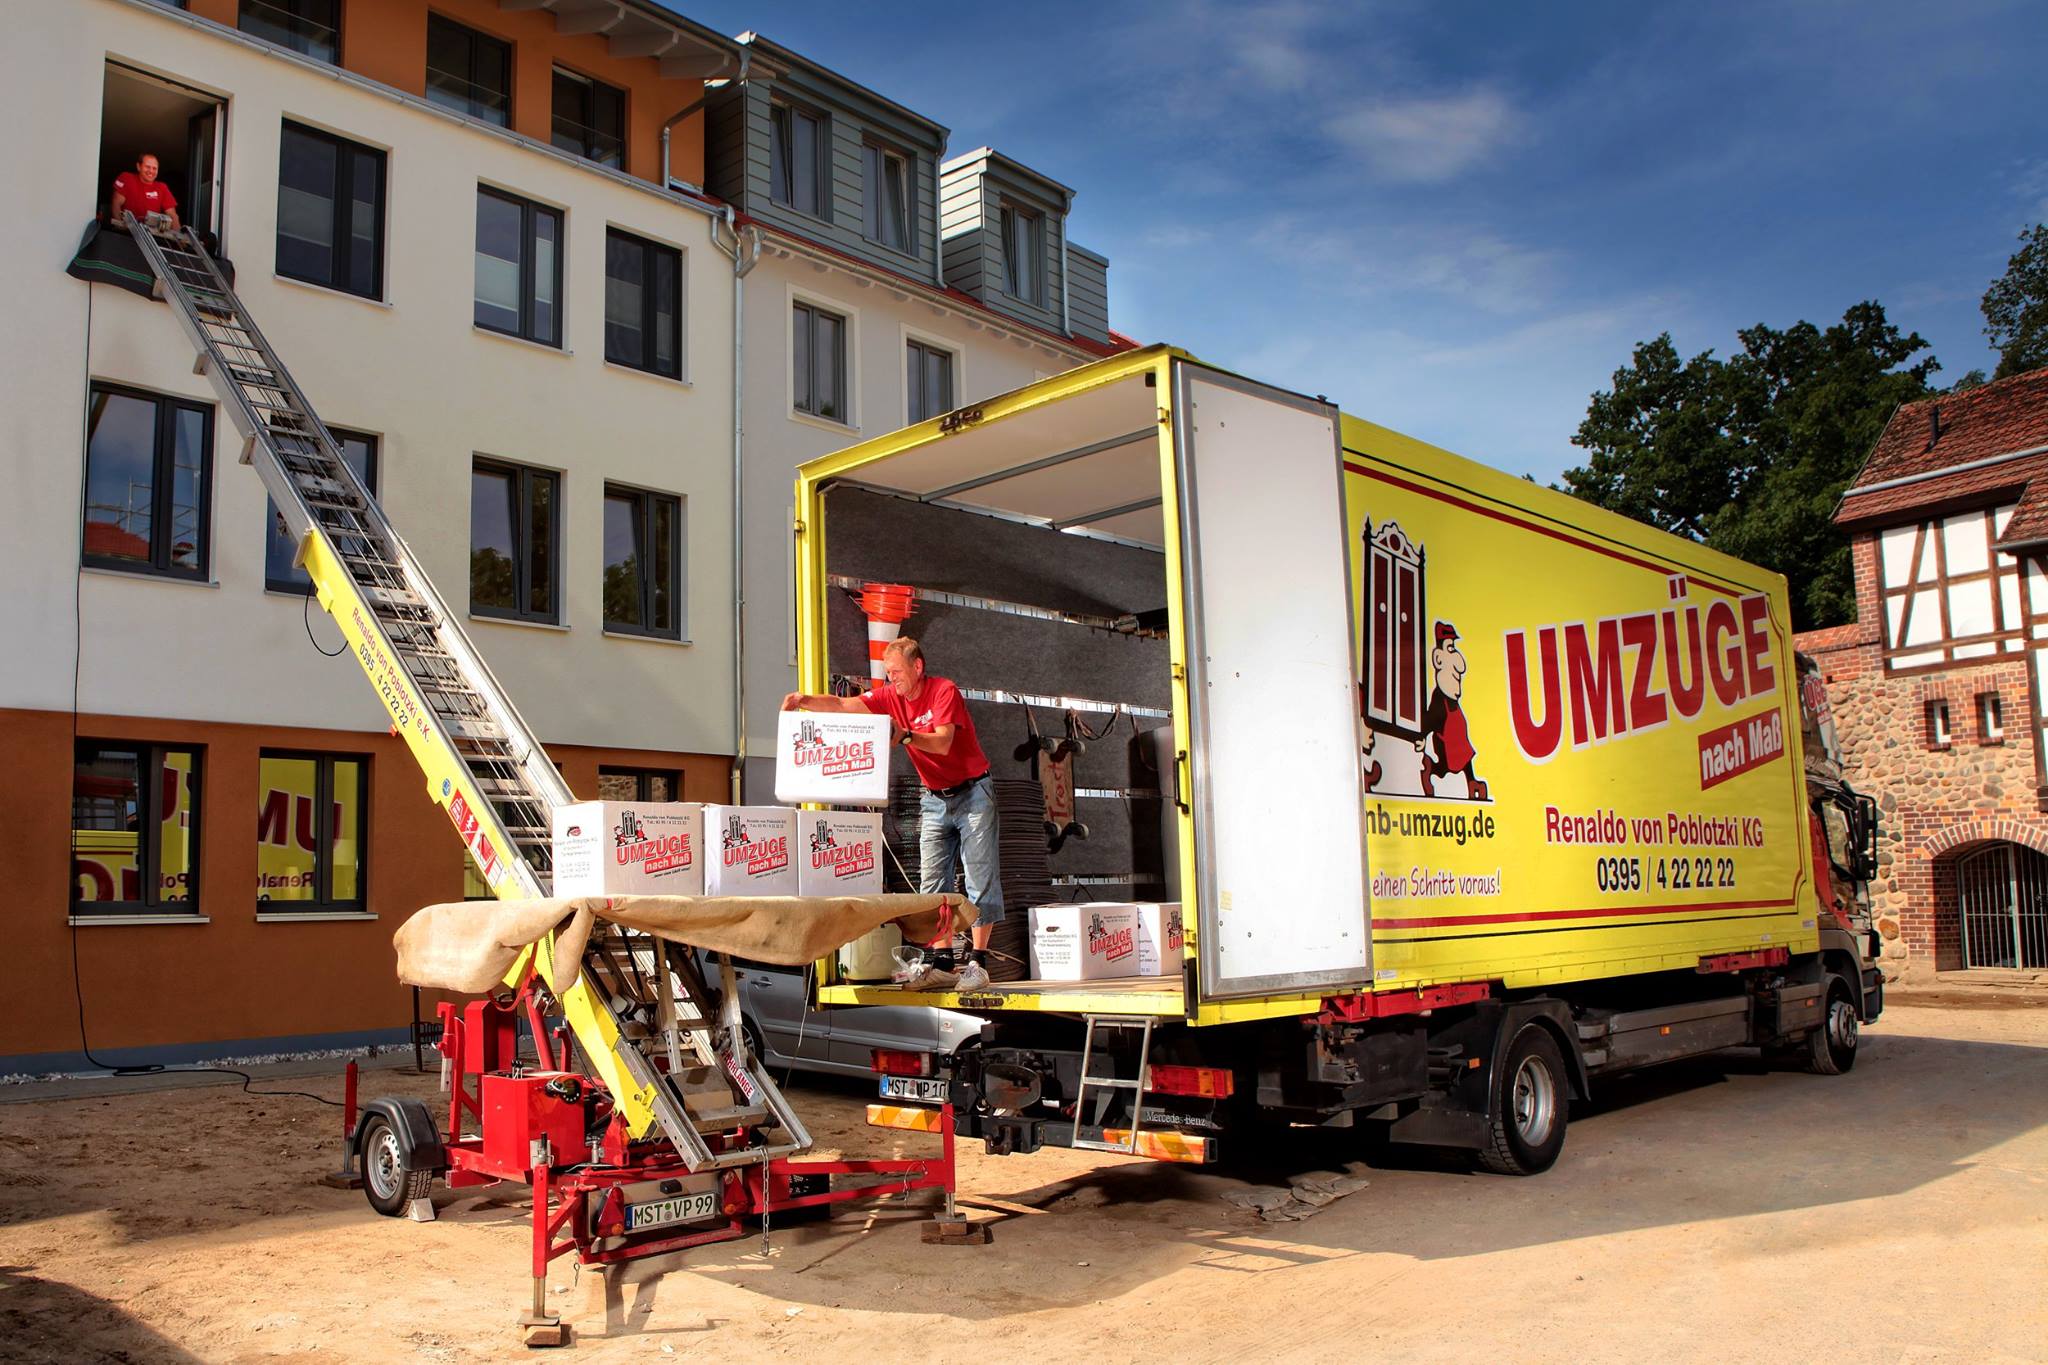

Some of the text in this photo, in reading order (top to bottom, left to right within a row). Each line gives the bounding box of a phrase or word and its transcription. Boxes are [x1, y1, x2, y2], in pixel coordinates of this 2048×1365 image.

[352, 607, 376, 650] Renaldo
[375, 649, 388, 670] von
[388, 666, 418, 719] Poblotzki
[1504, 575, 1776, 762] UMZÜGE
[359, 643, 375, 671] 0395
[377, 675, 383, 685] 4
[382, 681, 392, 700] 22
[390, 695, 400, 714] 22
[399, 710, 409, 728] 22
[794, 741, 874, 767] UMZÜGE
[1702, 712, 1783, 781] nach Maß
[824, 759, 872, 774] nach Maß
[1366, 803, 1495, 845] nb-umzug.de
[1545, 806, 1764, 847] Renaldo von Poblotzki KG
[616, 833, 691, 865] UMZÜGE
[646, 858, 669, 872] nach
[671, 853, 690, 866] Maß
[724, 836, 787, 867] UMZÜGE
[812, 841, 873, 869] UMZÜGE
[749, 860, 769, 872] nach
[836, 858, 873, 875] nach Maß
[1596, 857, 1641, 892] 0395
[1657, 858, 1667, 888] 4
[1671, 858, 1690, 889] 22
[1695, 857, 1713, 887] 22
[1717, 857, 1735, 887] 22
[1372, 867, 1500, 897] einen Schritt voraus!
[634, 1195, 713, 1226] MST VP 99
